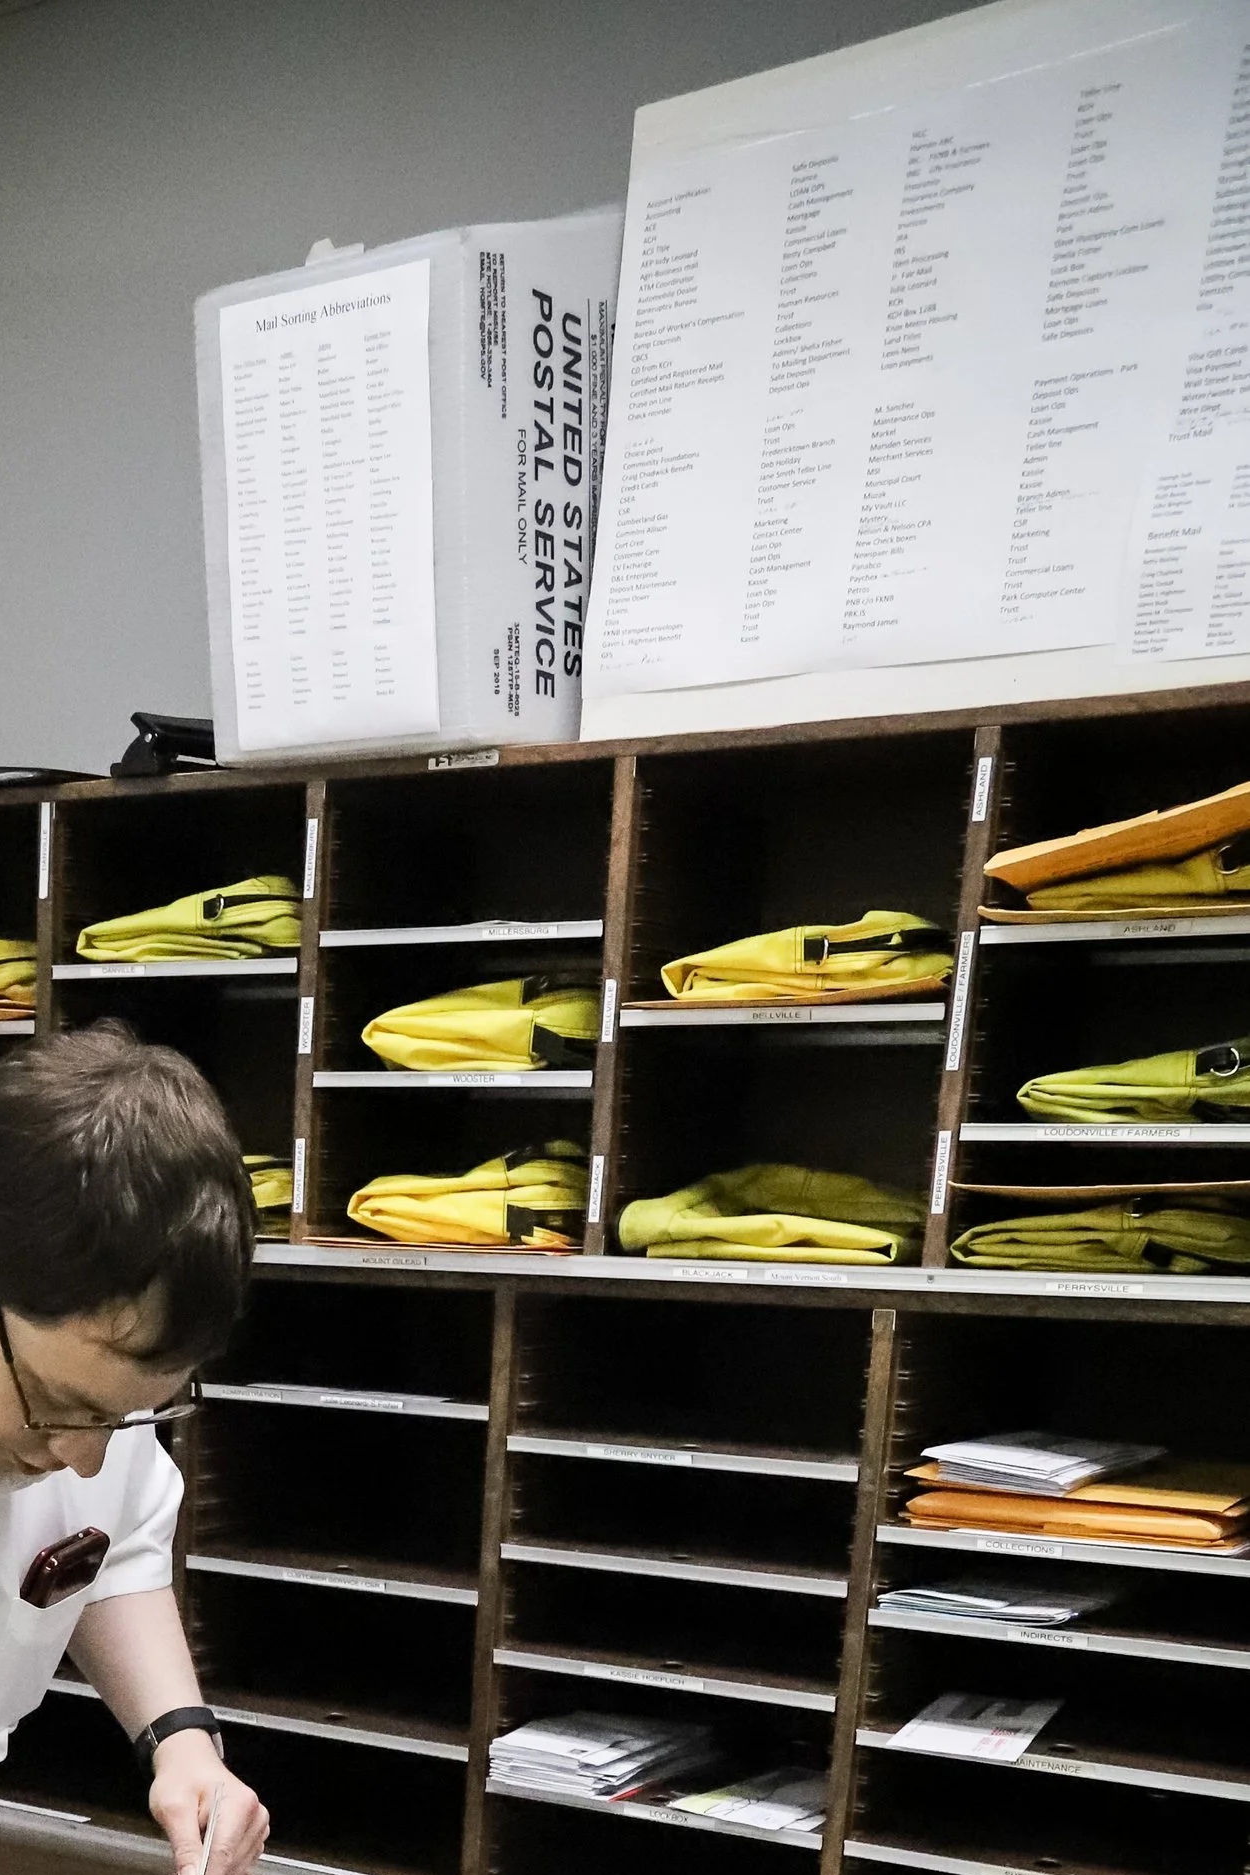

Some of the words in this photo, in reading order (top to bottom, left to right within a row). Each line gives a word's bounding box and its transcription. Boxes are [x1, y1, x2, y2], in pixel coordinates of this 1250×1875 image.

[492, 253, 498, 265] TO
[500, 295, 506, 308] TO
[256, 315, 278, 333] Mail
[281, 308, 317, 327] Sorting
[320, 291, 392, 319] Abbreviations
[532, 288, 554, 481] POSTAL
[599, 364, 607, 418] PENALTY
[562, 312, 582, 486] UNITED
[1168, 431, 1190, 442] Trust
[1192, 427, 1213, 439] Mail
[517, 428, 526, 466] FOR
[868, 452, 903, 464] Merchant
[517, 471, 526, 512] MAIL
[757, 482, 791, 494] Customer
[792, 478, 816, 488] Service
[518, 517, 527, 565] ONLY
[1147, 528, 1180, 541] Benefit
[1181, 526, 1202, 537] Mail
[563, 501, 583, 678] STATES
[534, 499, 555, 698] SERVICE
[842, 620, 876, 631] Raymond
[975, 763, 988, 816] ASHLAND
[306, 823, 316, 892] MILLERSBURG
[488, 926, 550, 936] MILLERSBURG
[1122, 923, 1176, 933] ASHLAND
[102, 966, 135, 974] DANVILLE
[949, 995, 966, 1068] LOUDONVILLE
[959, 933, 972, 986] FARMERS
[604, 985, 614, 1036] BELLVILLE
[752, 1010, 801, 1020] BELLVILLE
[301, 1002, 311, 1049] WOOSTER
[452, 1074, 496, 1084] WOOSTER
[1043, 1127, 1118, 1138] LOUDONVILLE
[1127, 1128, 1181, 1138] FARMERS
[934, 1136, 948, 1207] PERRYSVILLE
[590, 1163, 601, 1218] BLACKJACK
[362, 1257, 391, 1266] MOUNT
[681, 1268, 733, 1279] BLACKJACK
[770, 1272, 793, 1281] Mount
[794, 1273, 820, 1281] Vernon
[821, 1273, 842, 1282] South
[1057, 1283, 1129, 1293] PERRYSVILLE
[985, 1541, 1055, 1554] COLLECTIONS
[1020, 1631, 1073, 1643] INDIRECTS
[610, 1670, 639, 1680] KASSIE
[650, 1811, 689, 1823] LOCKBOX
